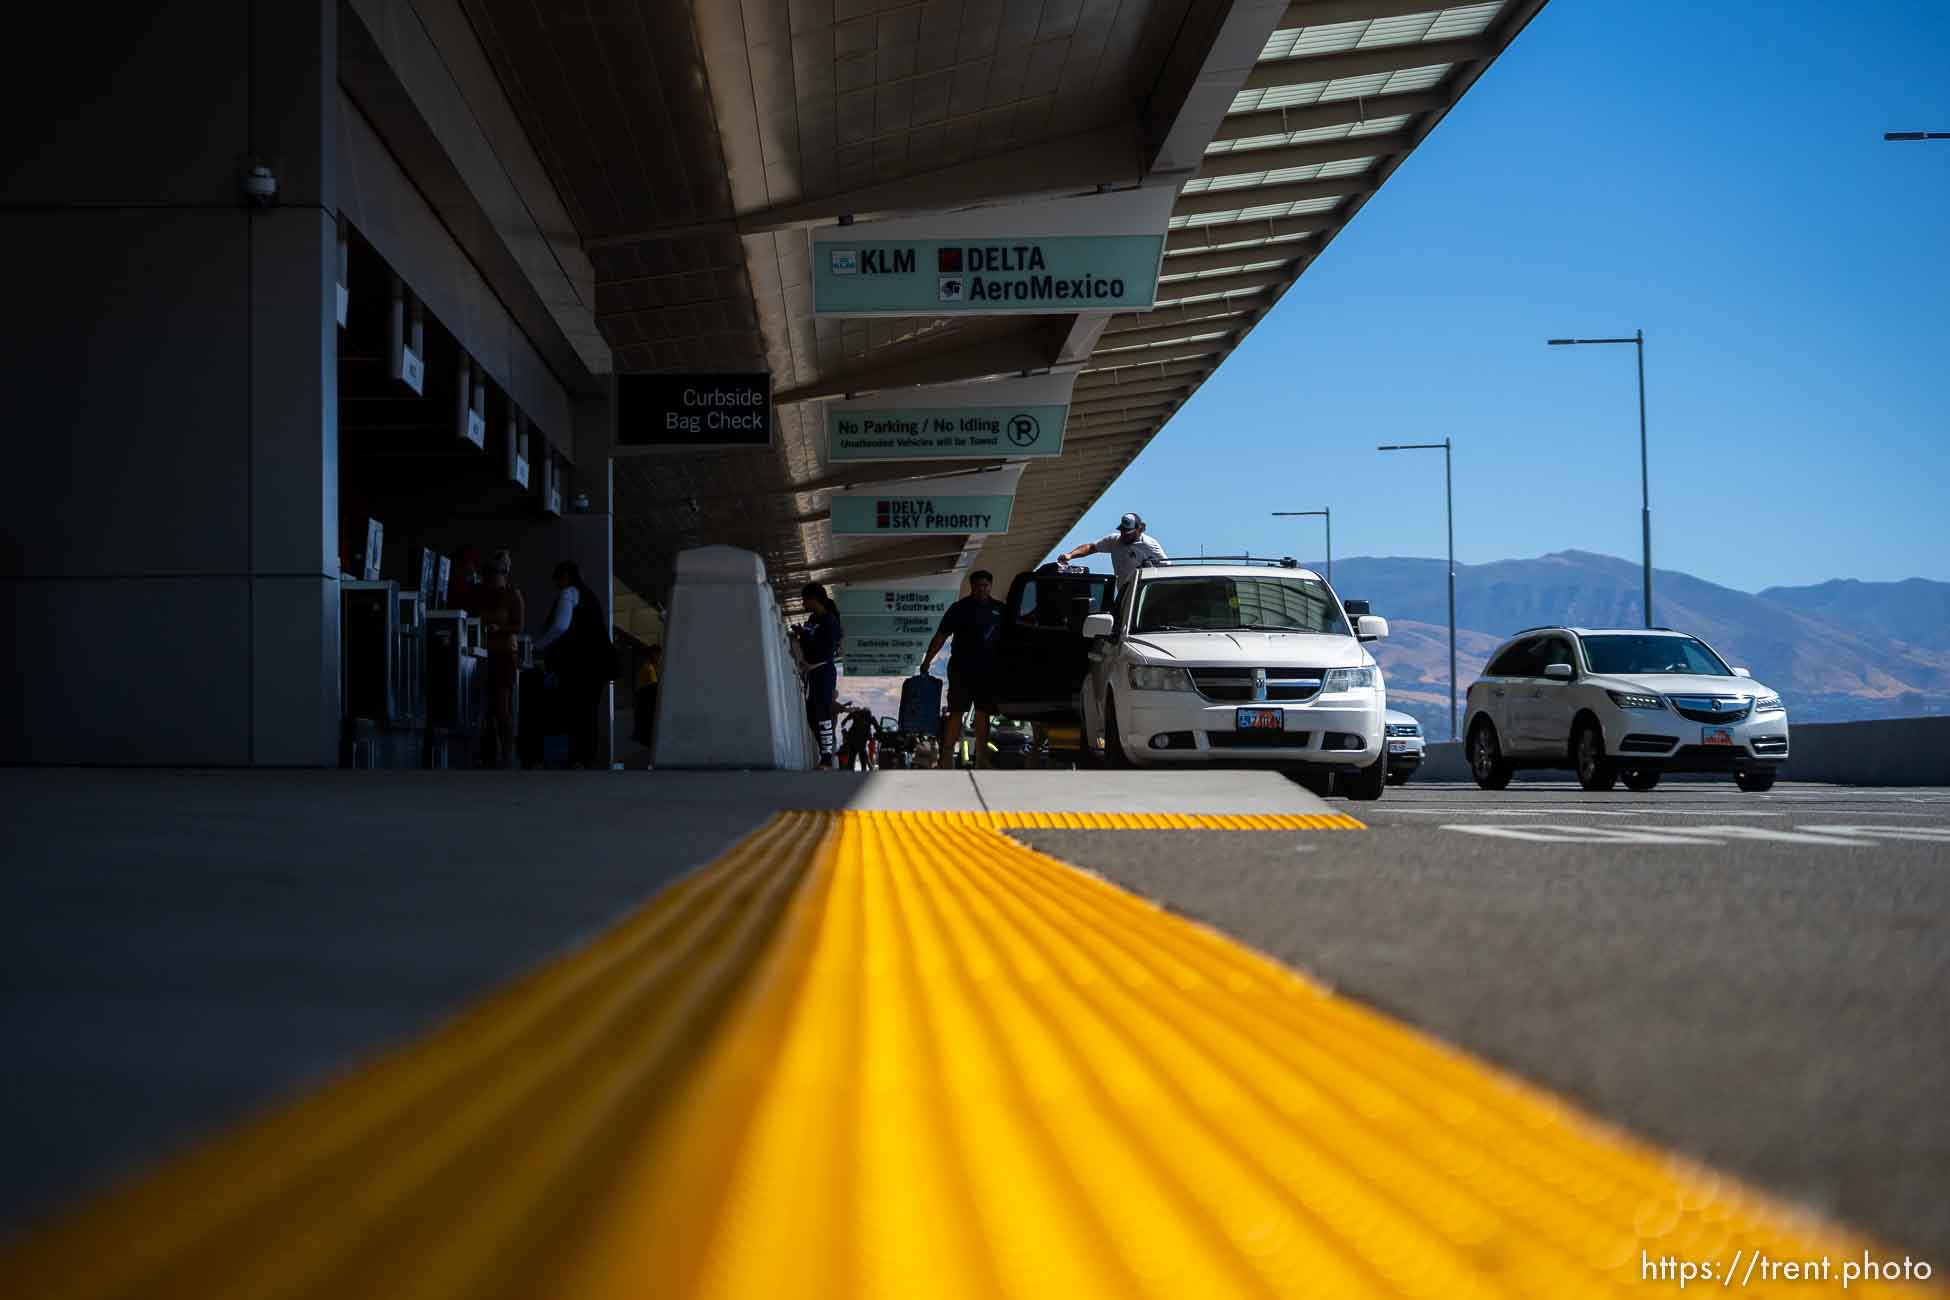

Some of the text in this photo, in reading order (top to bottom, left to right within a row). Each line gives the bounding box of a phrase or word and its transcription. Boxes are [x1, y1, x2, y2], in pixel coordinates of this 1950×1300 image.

[861, 246, 1046, 275] KLM DELTA
[969, 274, 1125, 301] AeroMexico
[683, 387, 764, 407] Curbside
[666, 410, 763, 433] Bag Check
[838, 421, 859, 435] No
[864, 418, 918, 436] Parking
[934, 419, 954, 433] No
[960, 417, 1001, 433] Idling
[892, 501, 934, 514] DELTA
[892, 514, 991, 528] SKY PRIORITY
